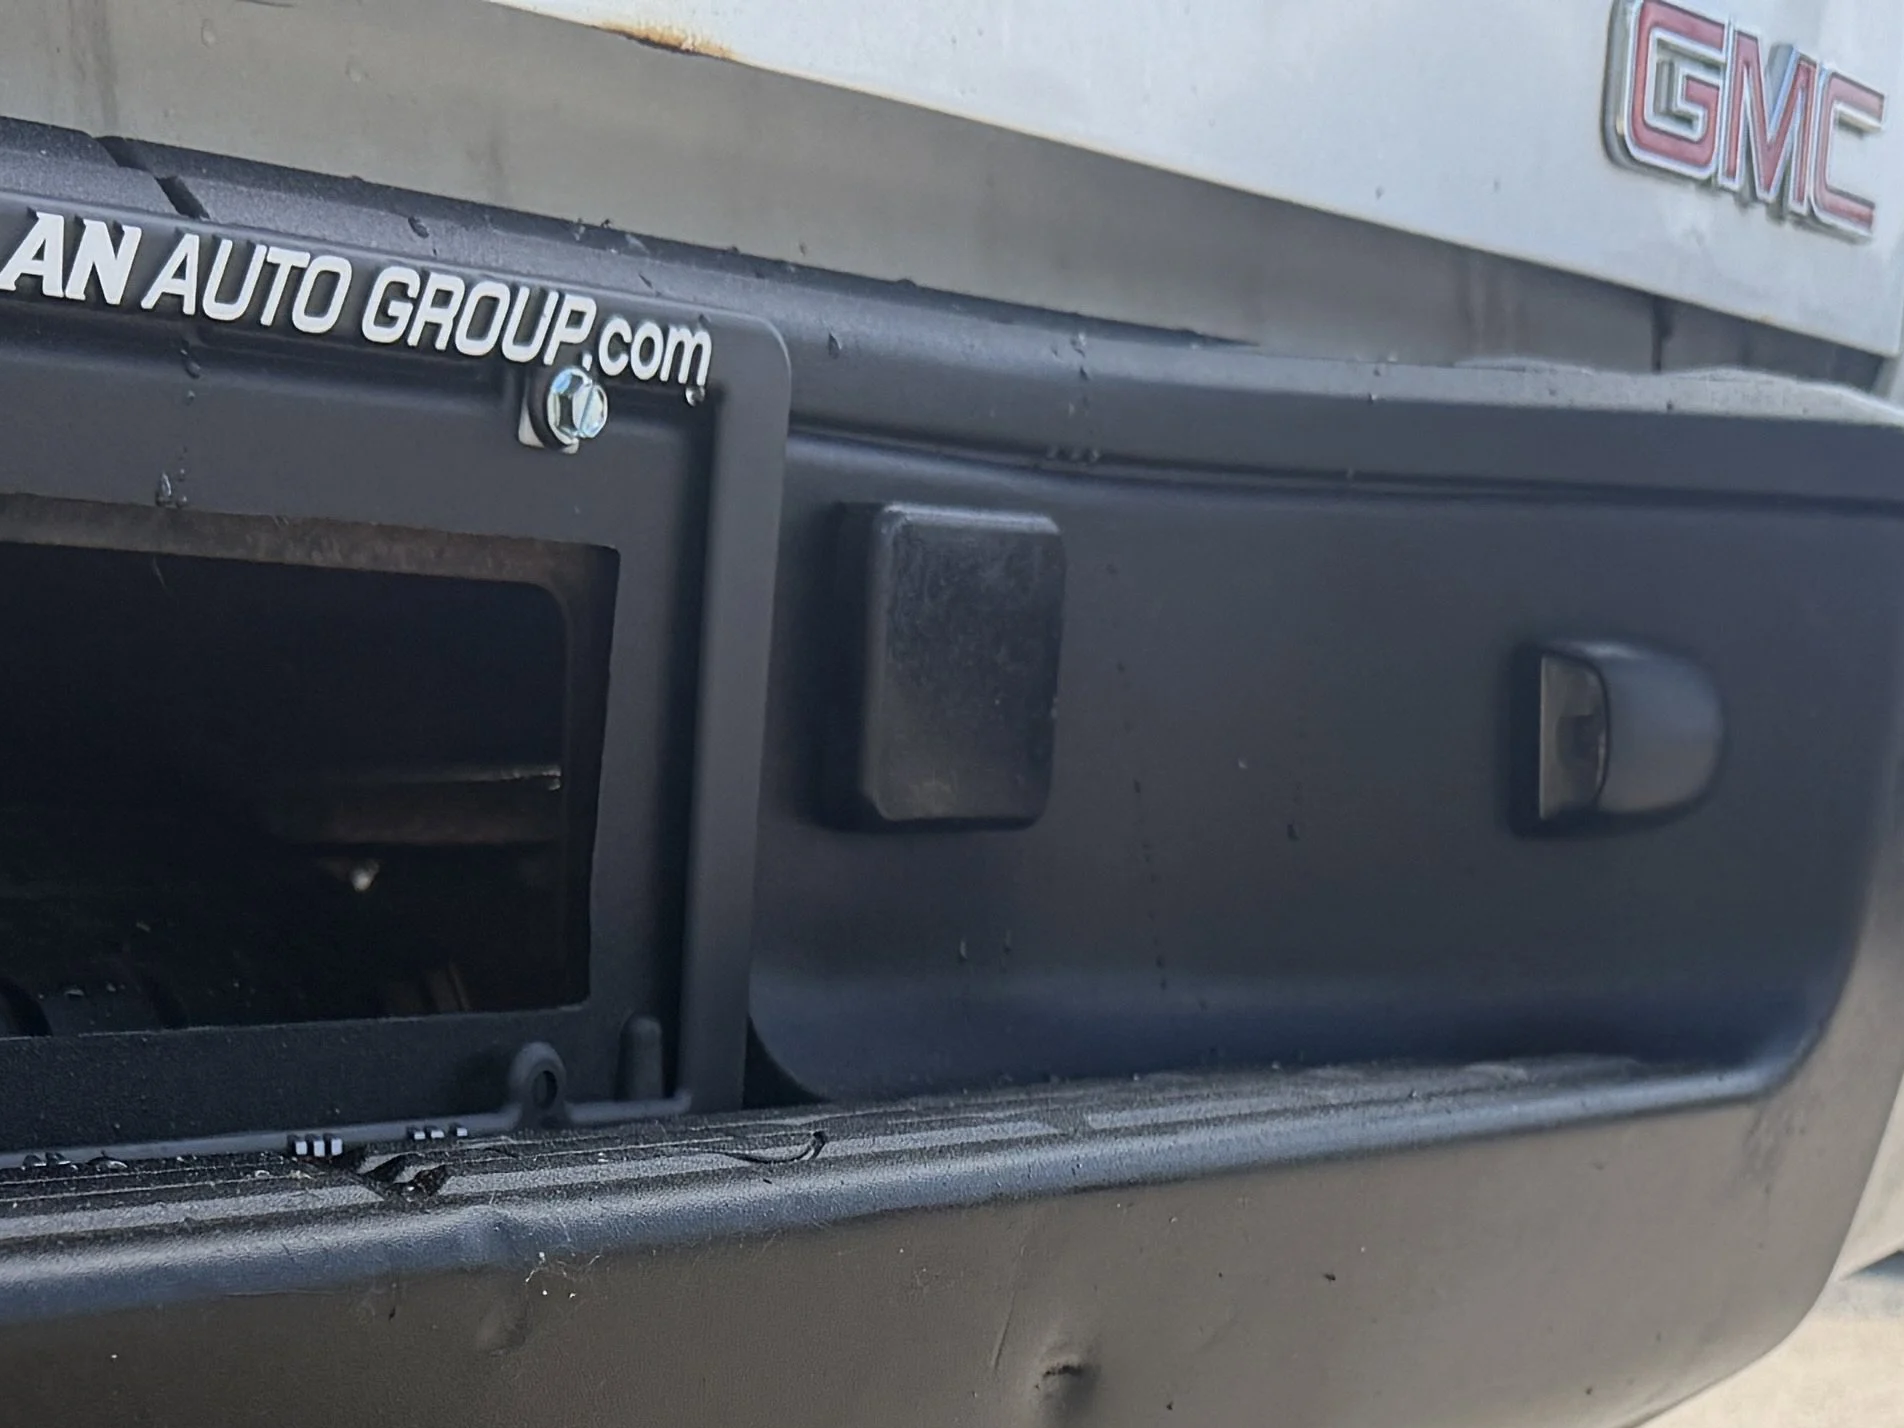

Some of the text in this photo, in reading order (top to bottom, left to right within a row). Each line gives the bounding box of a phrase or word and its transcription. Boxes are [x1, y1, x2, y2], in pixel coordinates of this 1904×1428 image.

[1624, 0, 1886, 240] GMC
[142, 235, 352, 335] AUTO
[361, 266, 713, 388] GROUP.com
